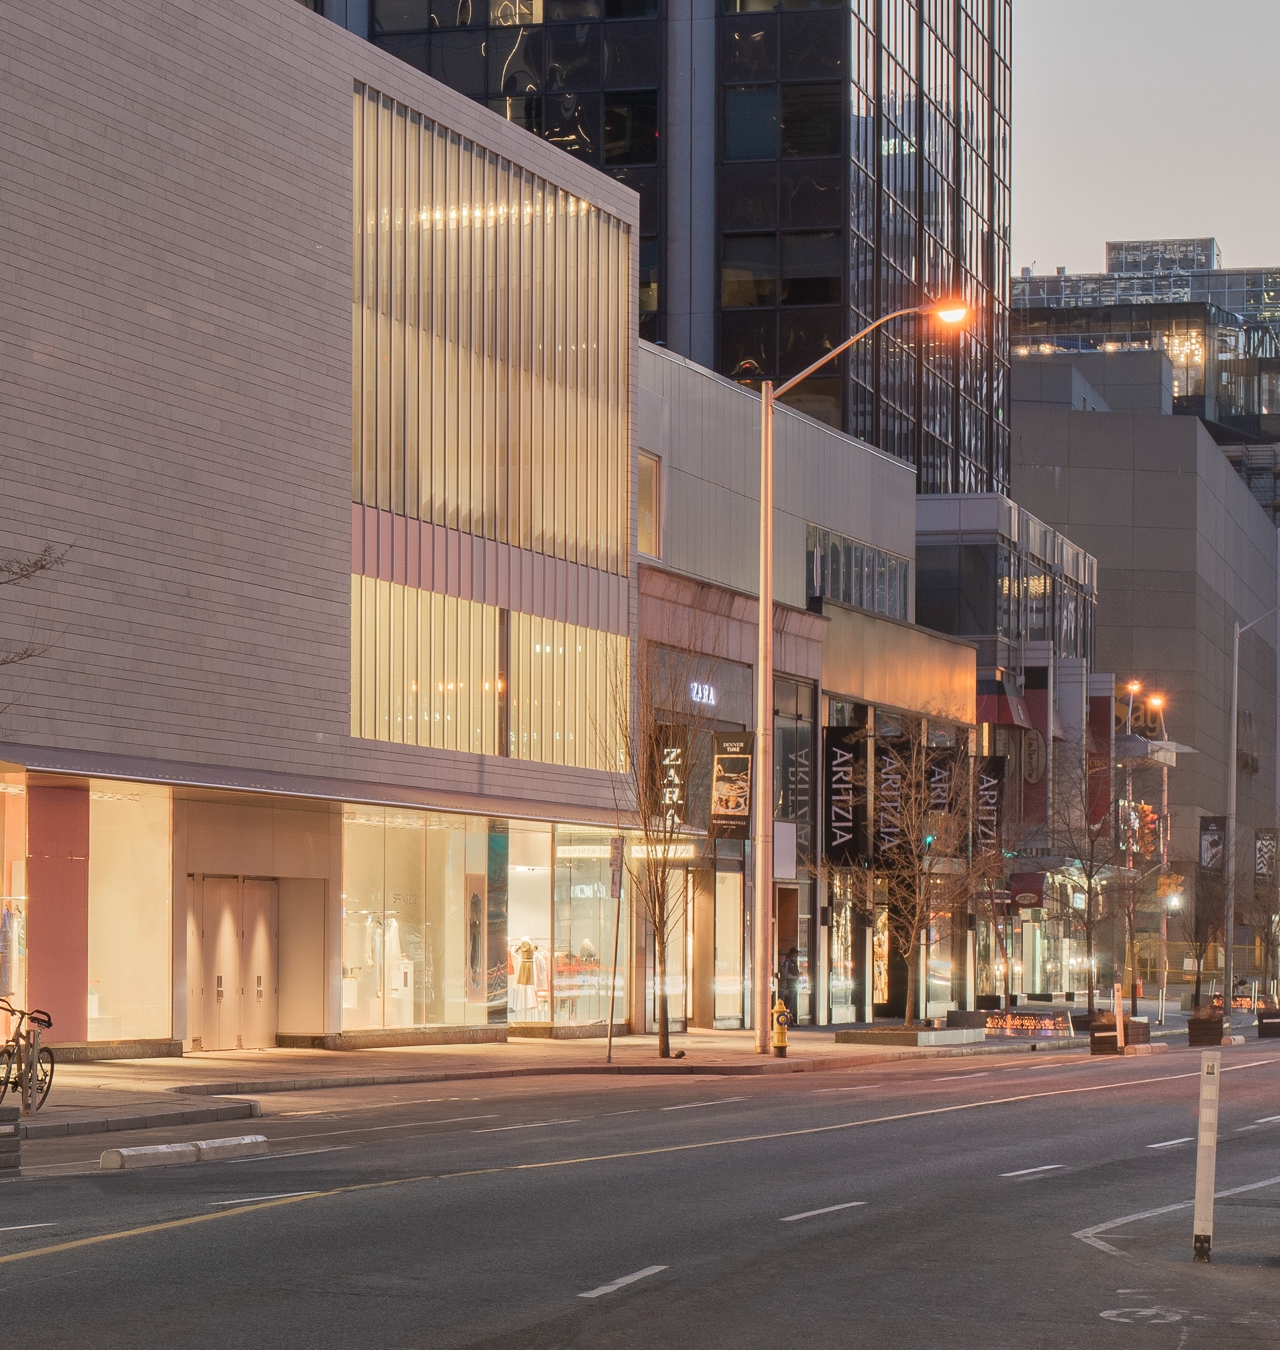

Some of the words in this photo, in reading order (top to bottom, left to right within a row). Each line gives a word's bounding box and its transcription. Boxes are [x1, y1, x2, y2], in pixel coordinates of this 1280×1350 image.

[691, 682, 715, 705] ZARA
[661, 748, 683, 824] ZARA
[832, 747, 853, 847] ARITZIA
[880, 755, 902, 851] ARITZIA
